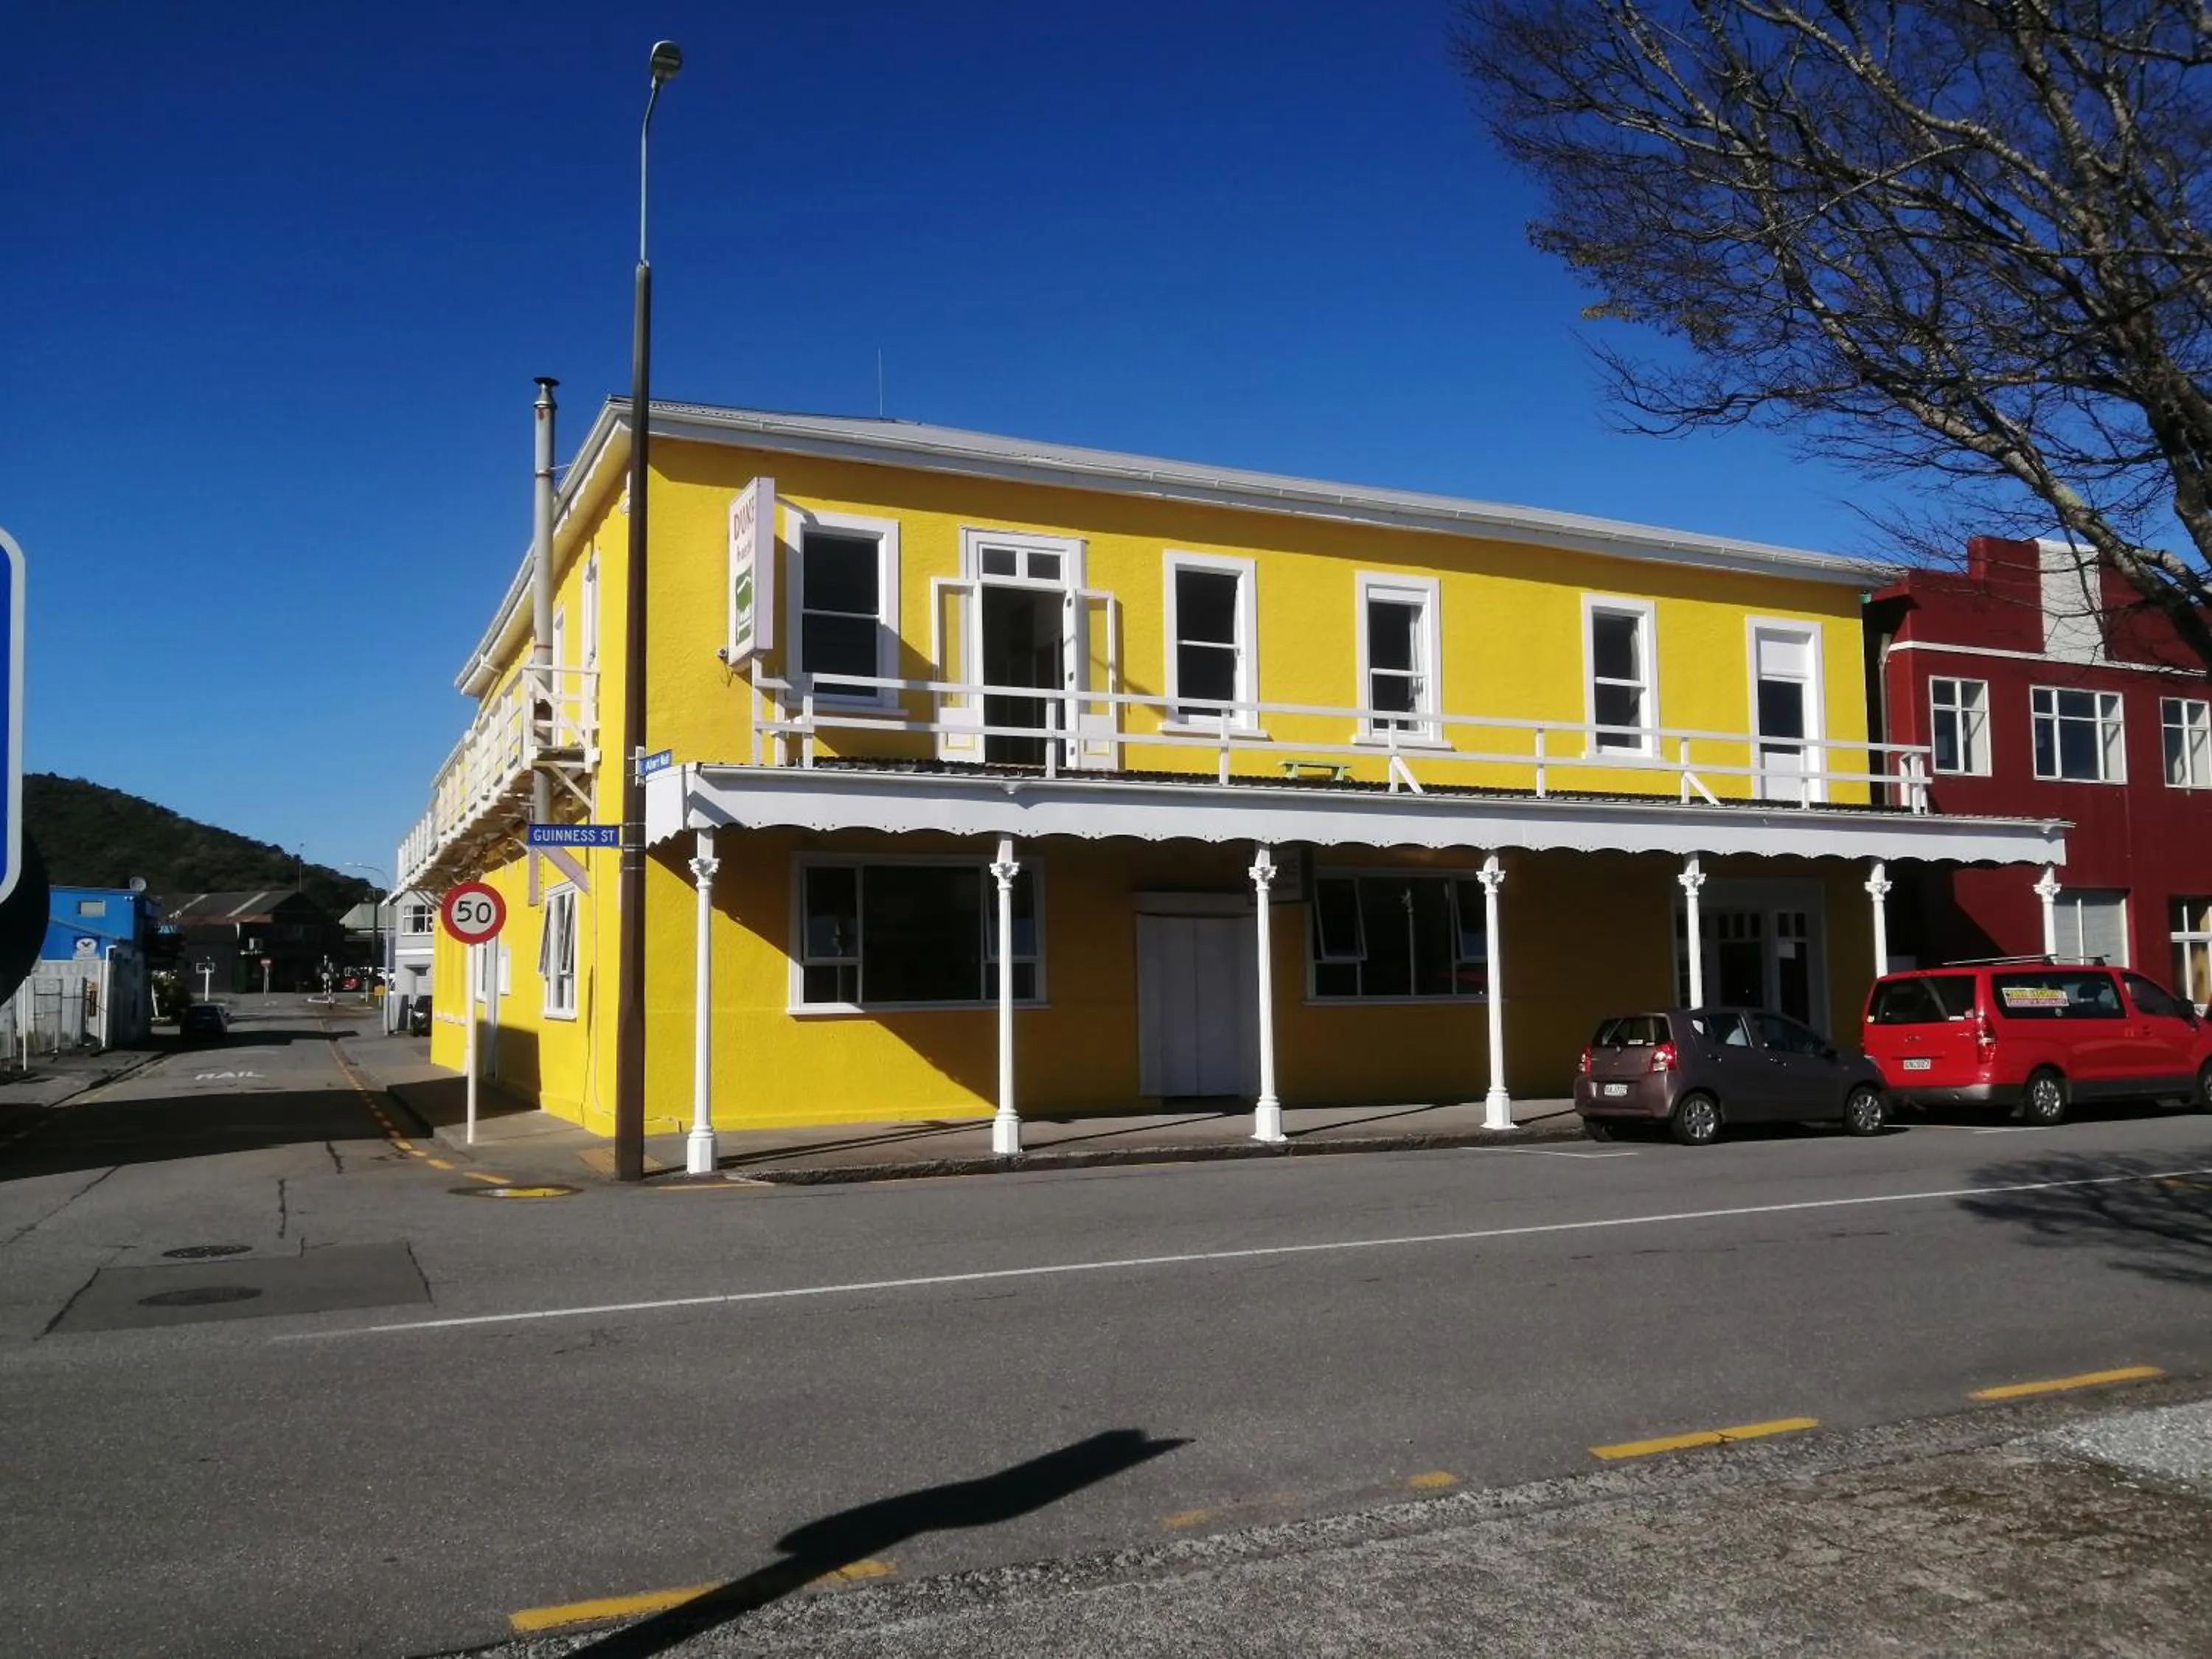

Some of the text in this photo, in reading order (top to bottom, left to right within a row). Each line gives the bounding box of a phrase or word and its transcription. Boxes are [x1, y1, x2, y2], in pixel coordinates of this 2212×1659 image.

[533, 828, 614, 843] GUINNESS ST
[456, 901, 492, 924] 50
